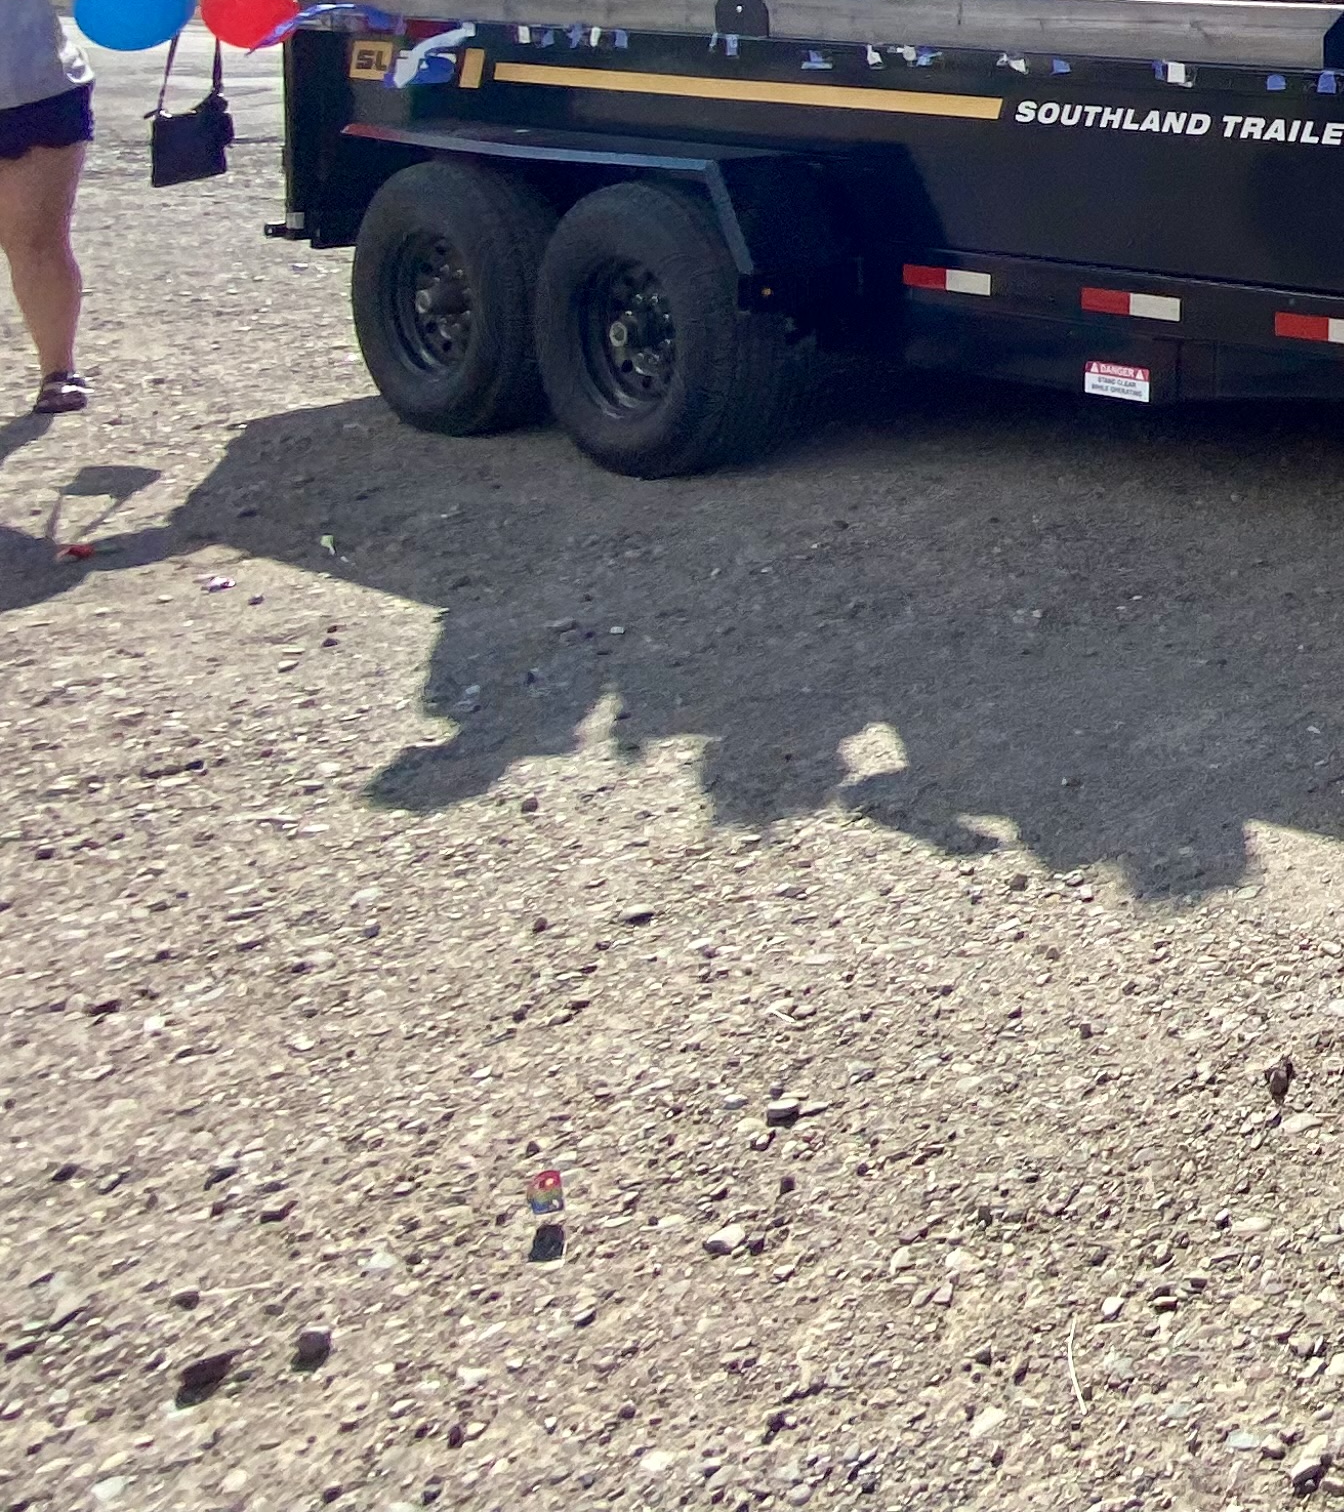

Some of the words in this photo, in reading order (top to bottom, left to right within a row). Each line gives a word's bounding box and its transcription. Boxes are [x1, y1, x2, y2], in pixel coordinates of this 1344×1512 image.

[355, 49, 387, 71] SL
[1015, 100, 1213, 136] SOUTHLAND
[1100, 363, 1134, 378] DANGER
